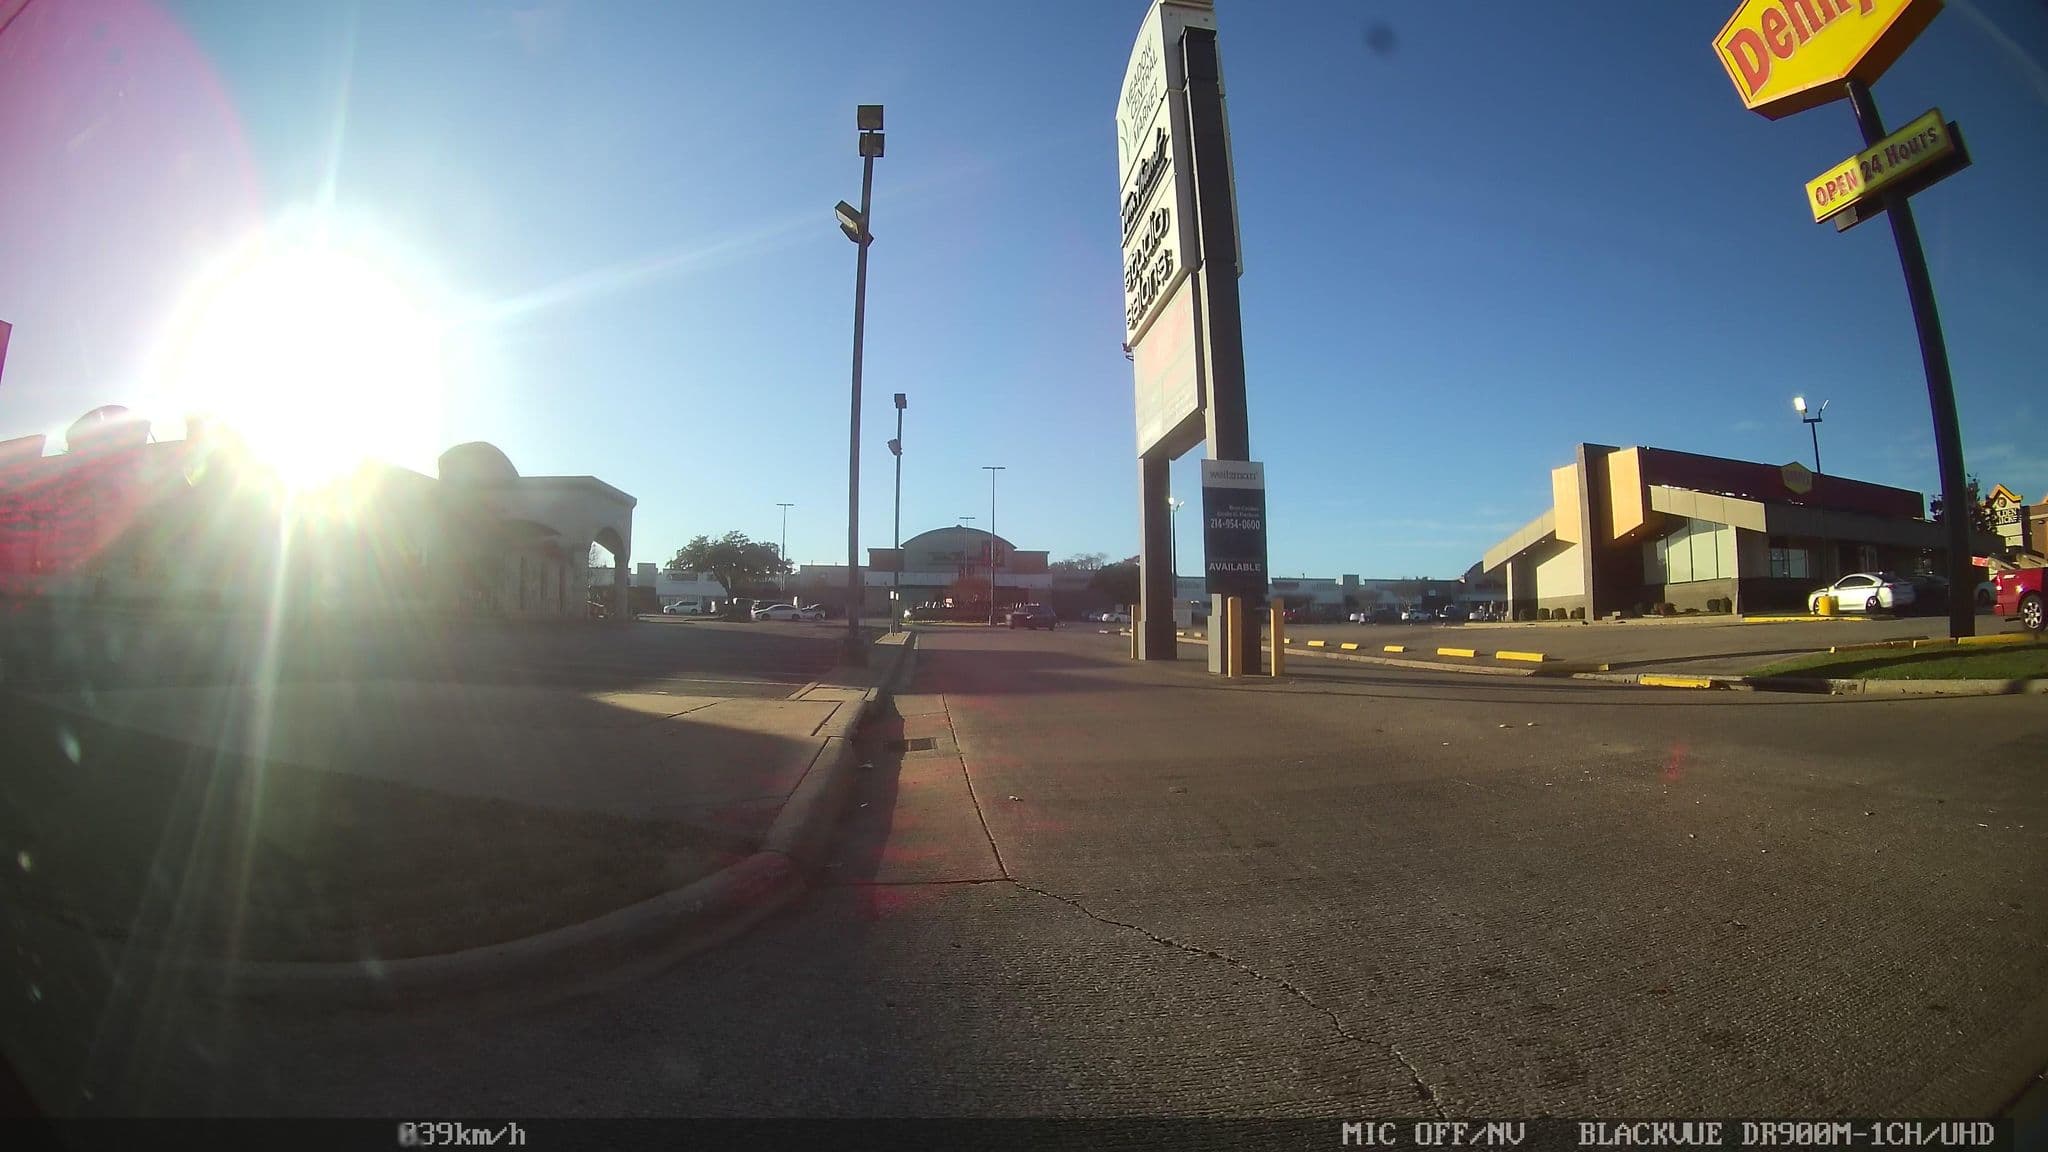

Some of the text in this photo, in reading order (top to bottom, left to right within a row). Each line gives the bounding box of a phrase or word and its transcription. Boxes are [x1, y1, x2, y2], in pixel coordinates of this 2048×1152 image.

[1131, 49, 1158, 119] CENTRAL
[1134, 77, 1158, 147] MARKET
[1815, 126, 1938, 207] OPEN 24 Hours
[1125, 208, 1170, 292] studio
[1127, 249, 1173, 330] salons
[1209, 562, 1261, 572] AVAILABLE
